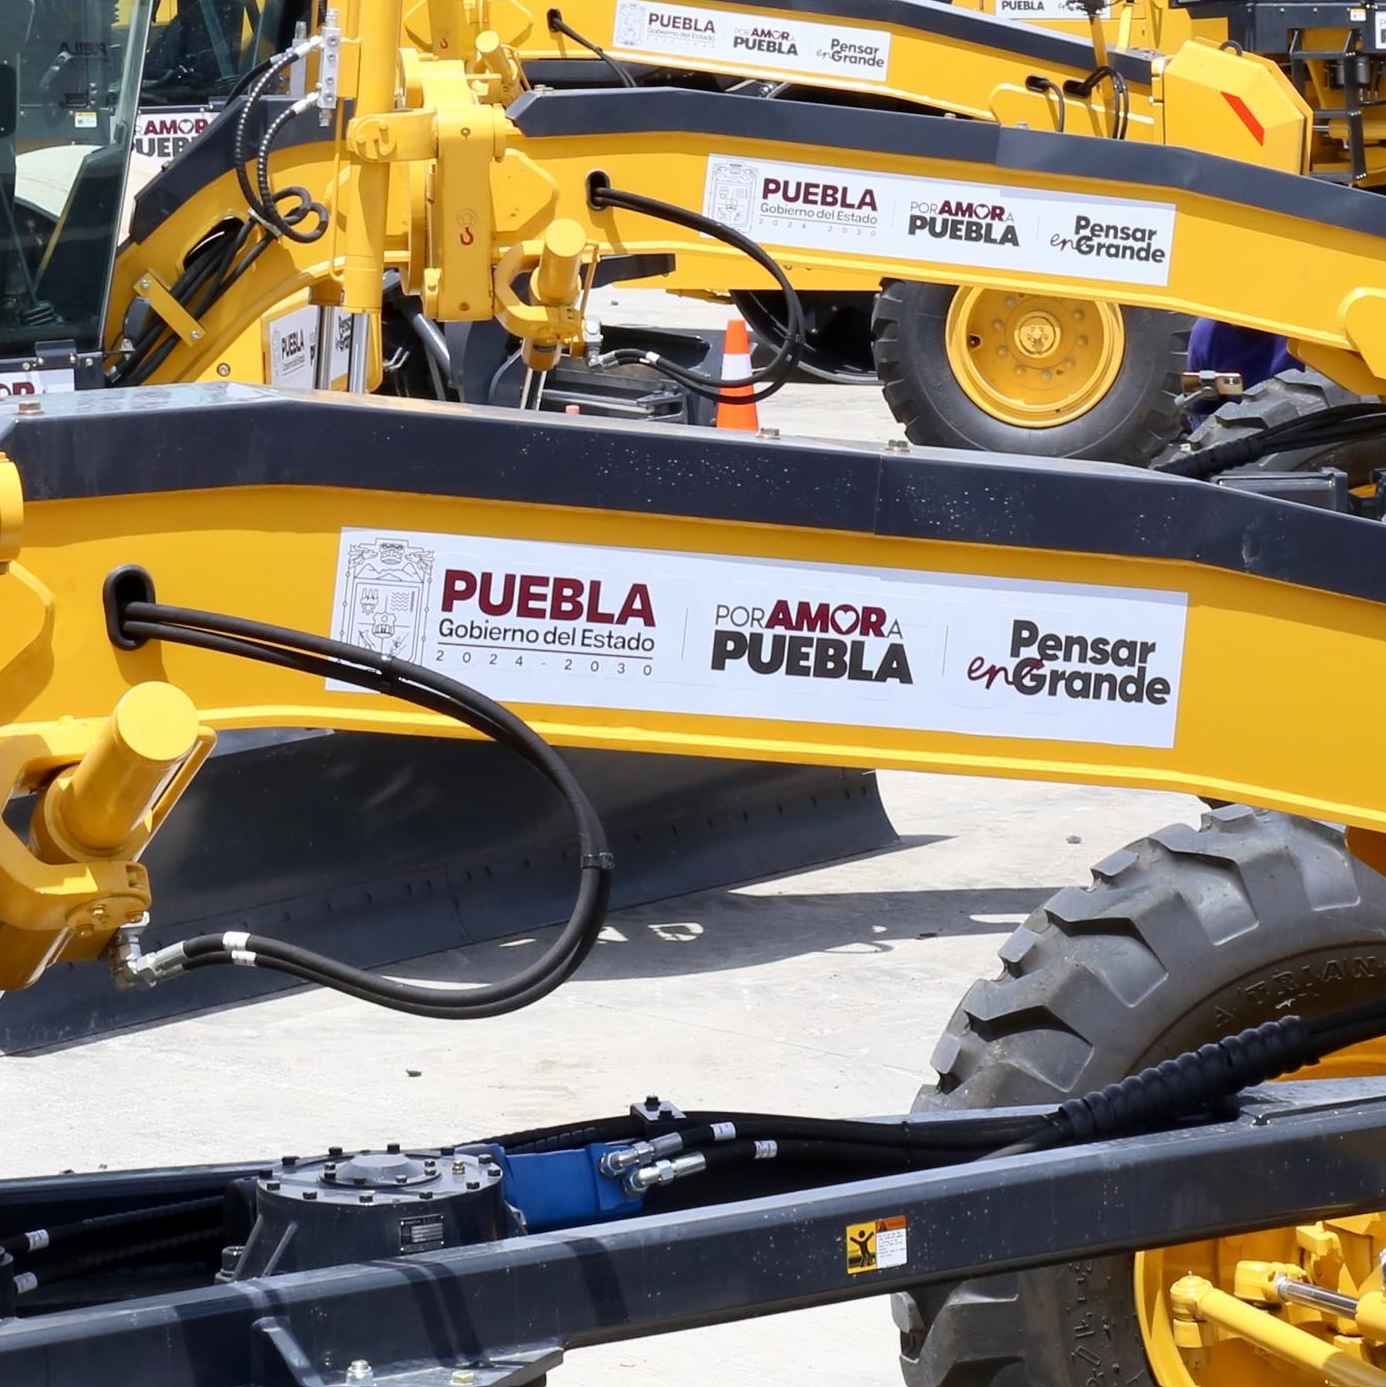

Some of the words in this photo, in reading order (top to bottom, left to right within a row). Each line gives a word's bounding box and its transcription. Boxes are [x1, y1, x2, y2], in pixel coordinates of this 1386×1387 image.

[1001, 0, 1044, 11] PUEBLA
[648, 13, 715, 34] PUEBLA
[750, 27, 790, 41] AMOR
[733, 36, 798, 56] PUEBLA
[830, 38, 880, 56] Pensar
[831, 50, 885, 68] Grande
[762, 177, 878, 211] PUEBLA
[760, 202, 815, 219] Gobierno
[816, 208, 835, 222] del
[836, 210, 878, 225] Estado
[909, 200, 938, 216] POR
[938, 199, 1006, 222] AMOR
[908, 214, 1020, 247] PUEBLA
[1074, 215, 1157, 242] Pensar
[1075, 234, 1166, 264] Grande
[281, 329, 305, 360] PUEBLA
[441, 569, 656, 627] PUEBLA
[714, 604, 765, 628] POR
[765, 599, 887, 638] AMOR
[887, 620, 904, 640] A
[438, 618, 538, 644] Gobierno
[543, 628, 576, 648] del
[580, 630, 656, 653] Estado
[1010, 619, 1156, 667] Pensar
[711, 630, 913, 684] PUEBLA
[967, 654, 1021, 690] en
[1013, 658, 1171, 705] Grande
